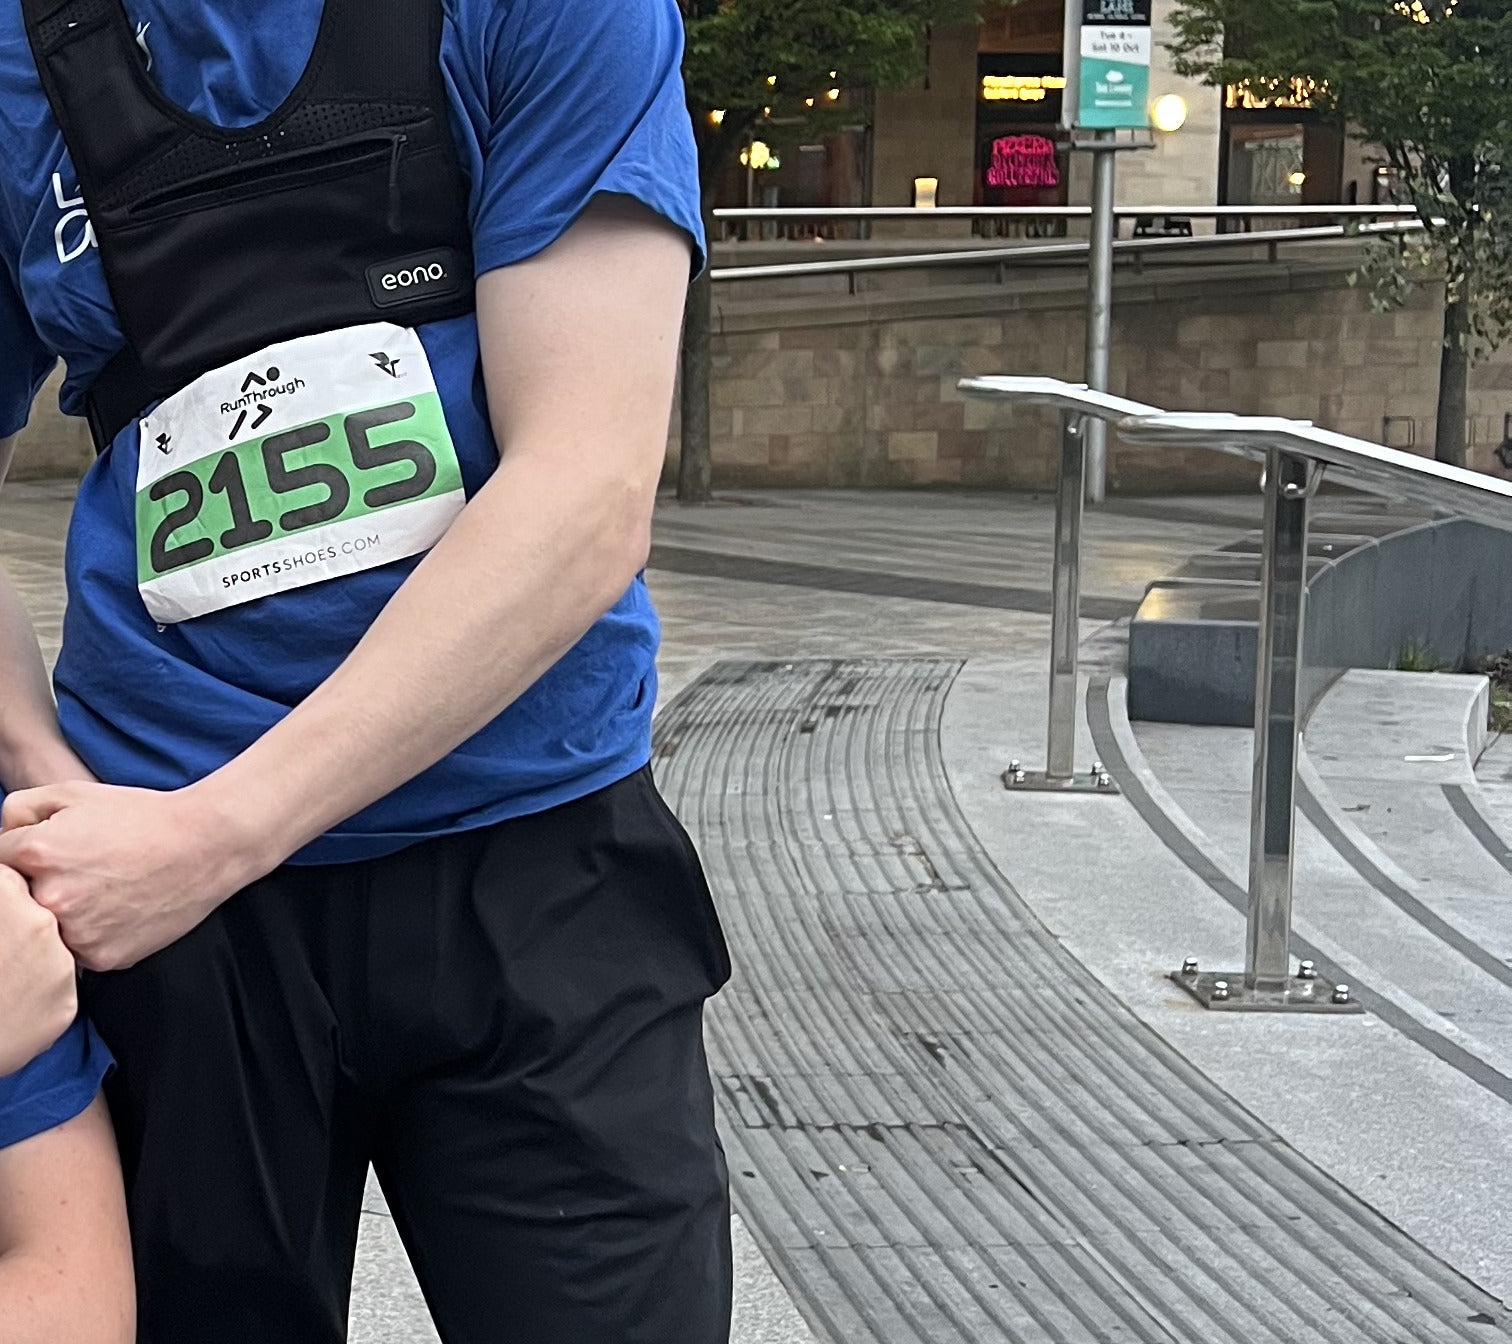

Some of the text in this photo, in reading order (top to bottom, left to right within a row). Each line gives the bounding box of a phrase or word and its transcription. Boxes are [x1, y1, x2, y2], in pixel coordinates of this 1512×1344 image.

[381, 263, 444, 290] eono
[220, 376, 306, 415] RunThrough
[149, 400, 437, 574] 2155
